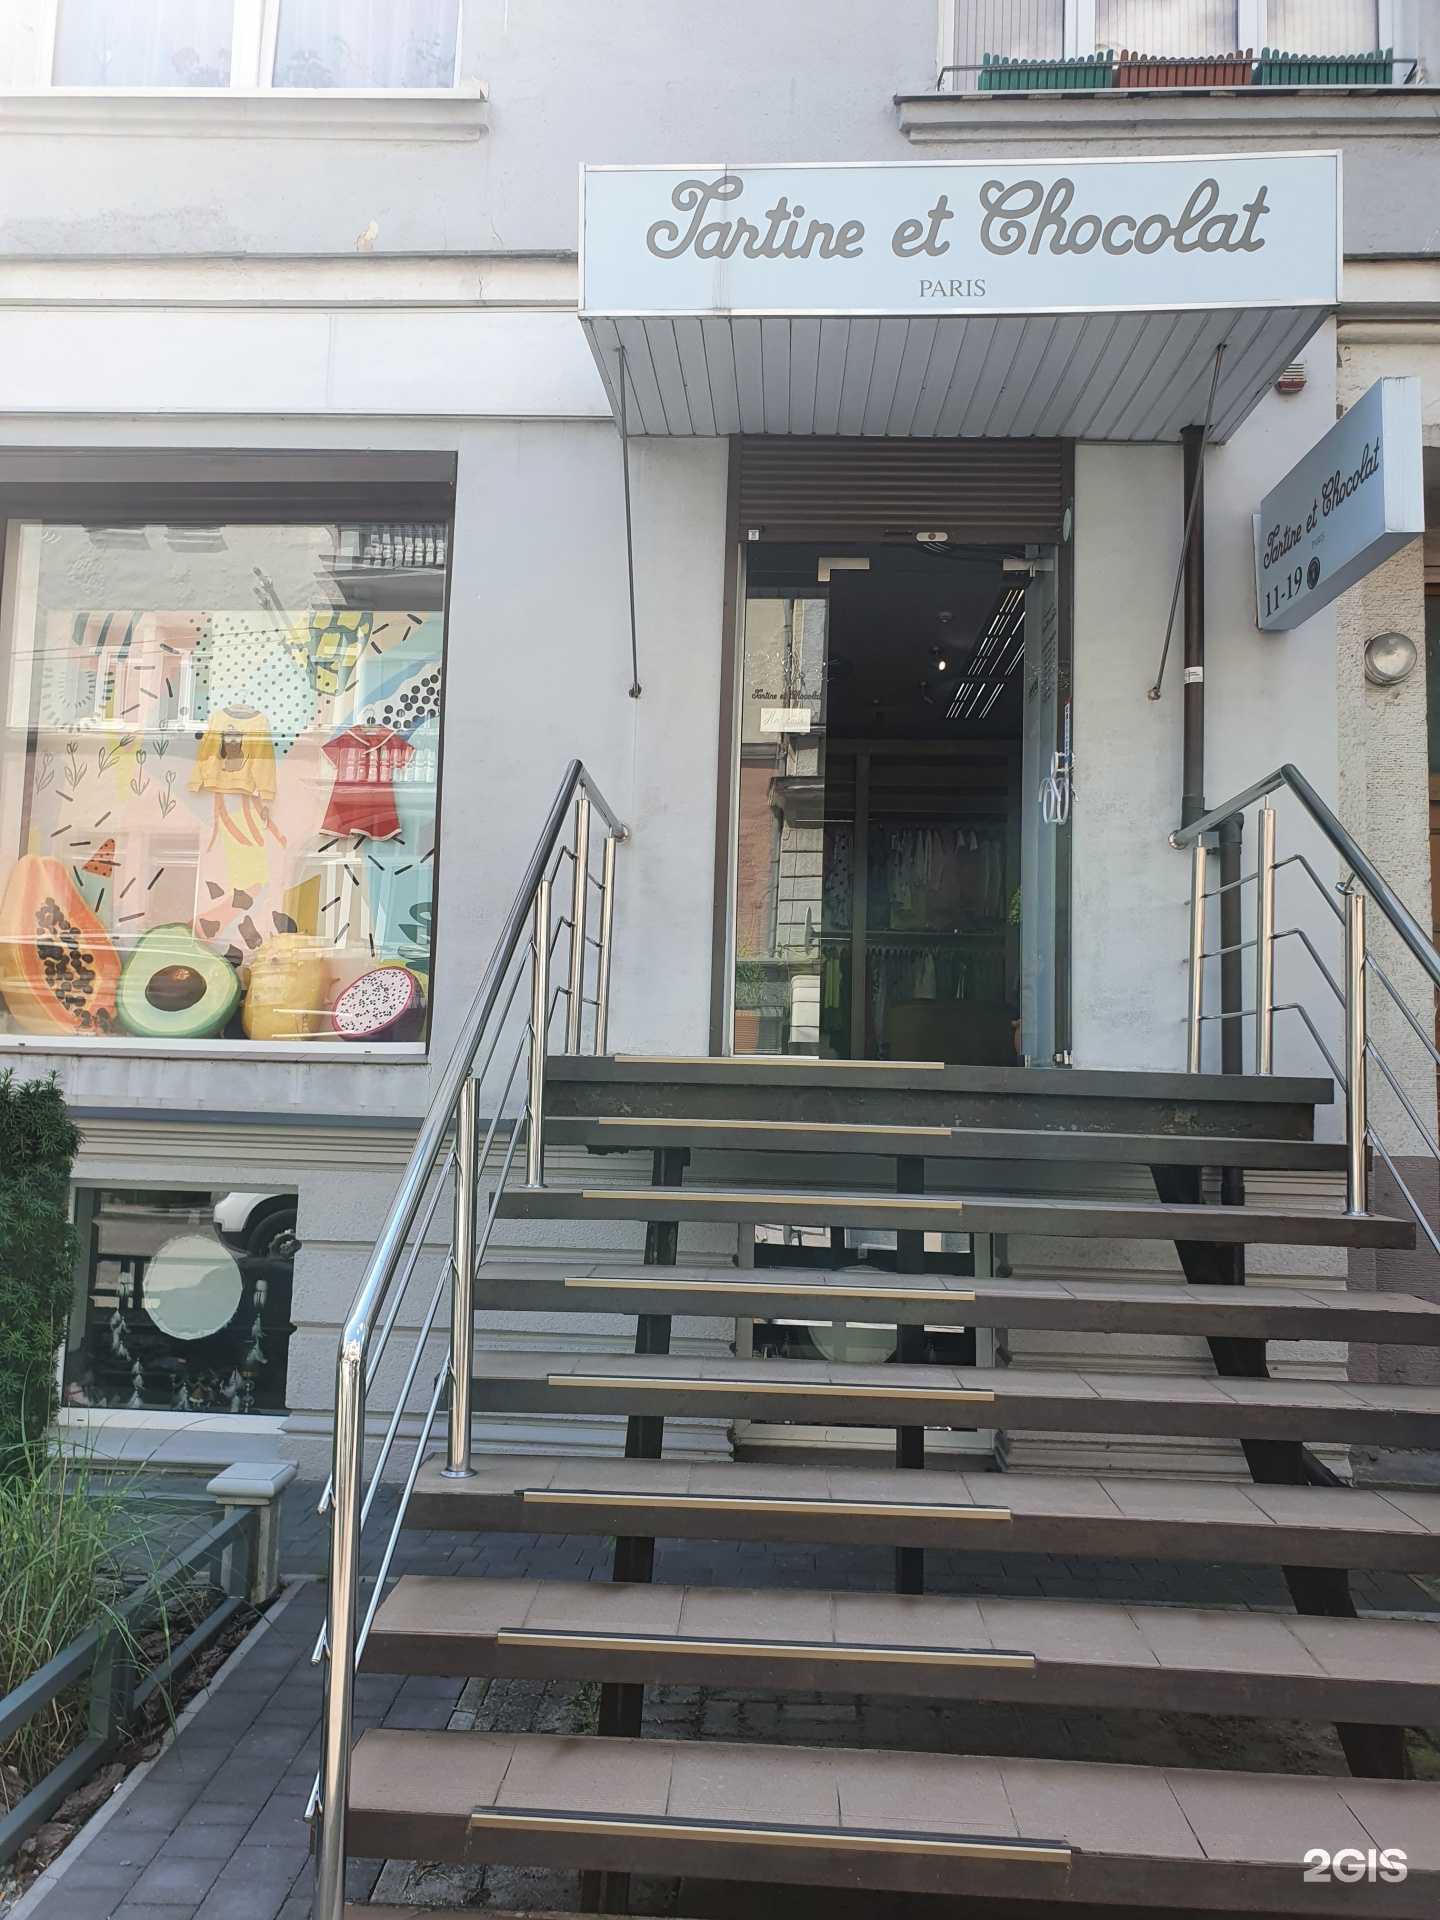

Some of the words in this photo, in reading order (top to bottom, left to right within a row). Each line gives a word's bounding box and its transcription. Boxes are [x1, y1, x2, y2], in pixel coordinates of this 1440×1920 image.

[646, 175, 865, 259] Tartine
[891, 195, 954, 257] et
[979, 178, 1270, 256] Chocolat
[919, 279, 986, 297] PARIS
[1263, 524, 1302, 570] Tartine
[1306, 500, 1317, 533] et
[1322, 437, 1380, 517] Chocolat
[1265, 566, 1302, 617] 11-19
